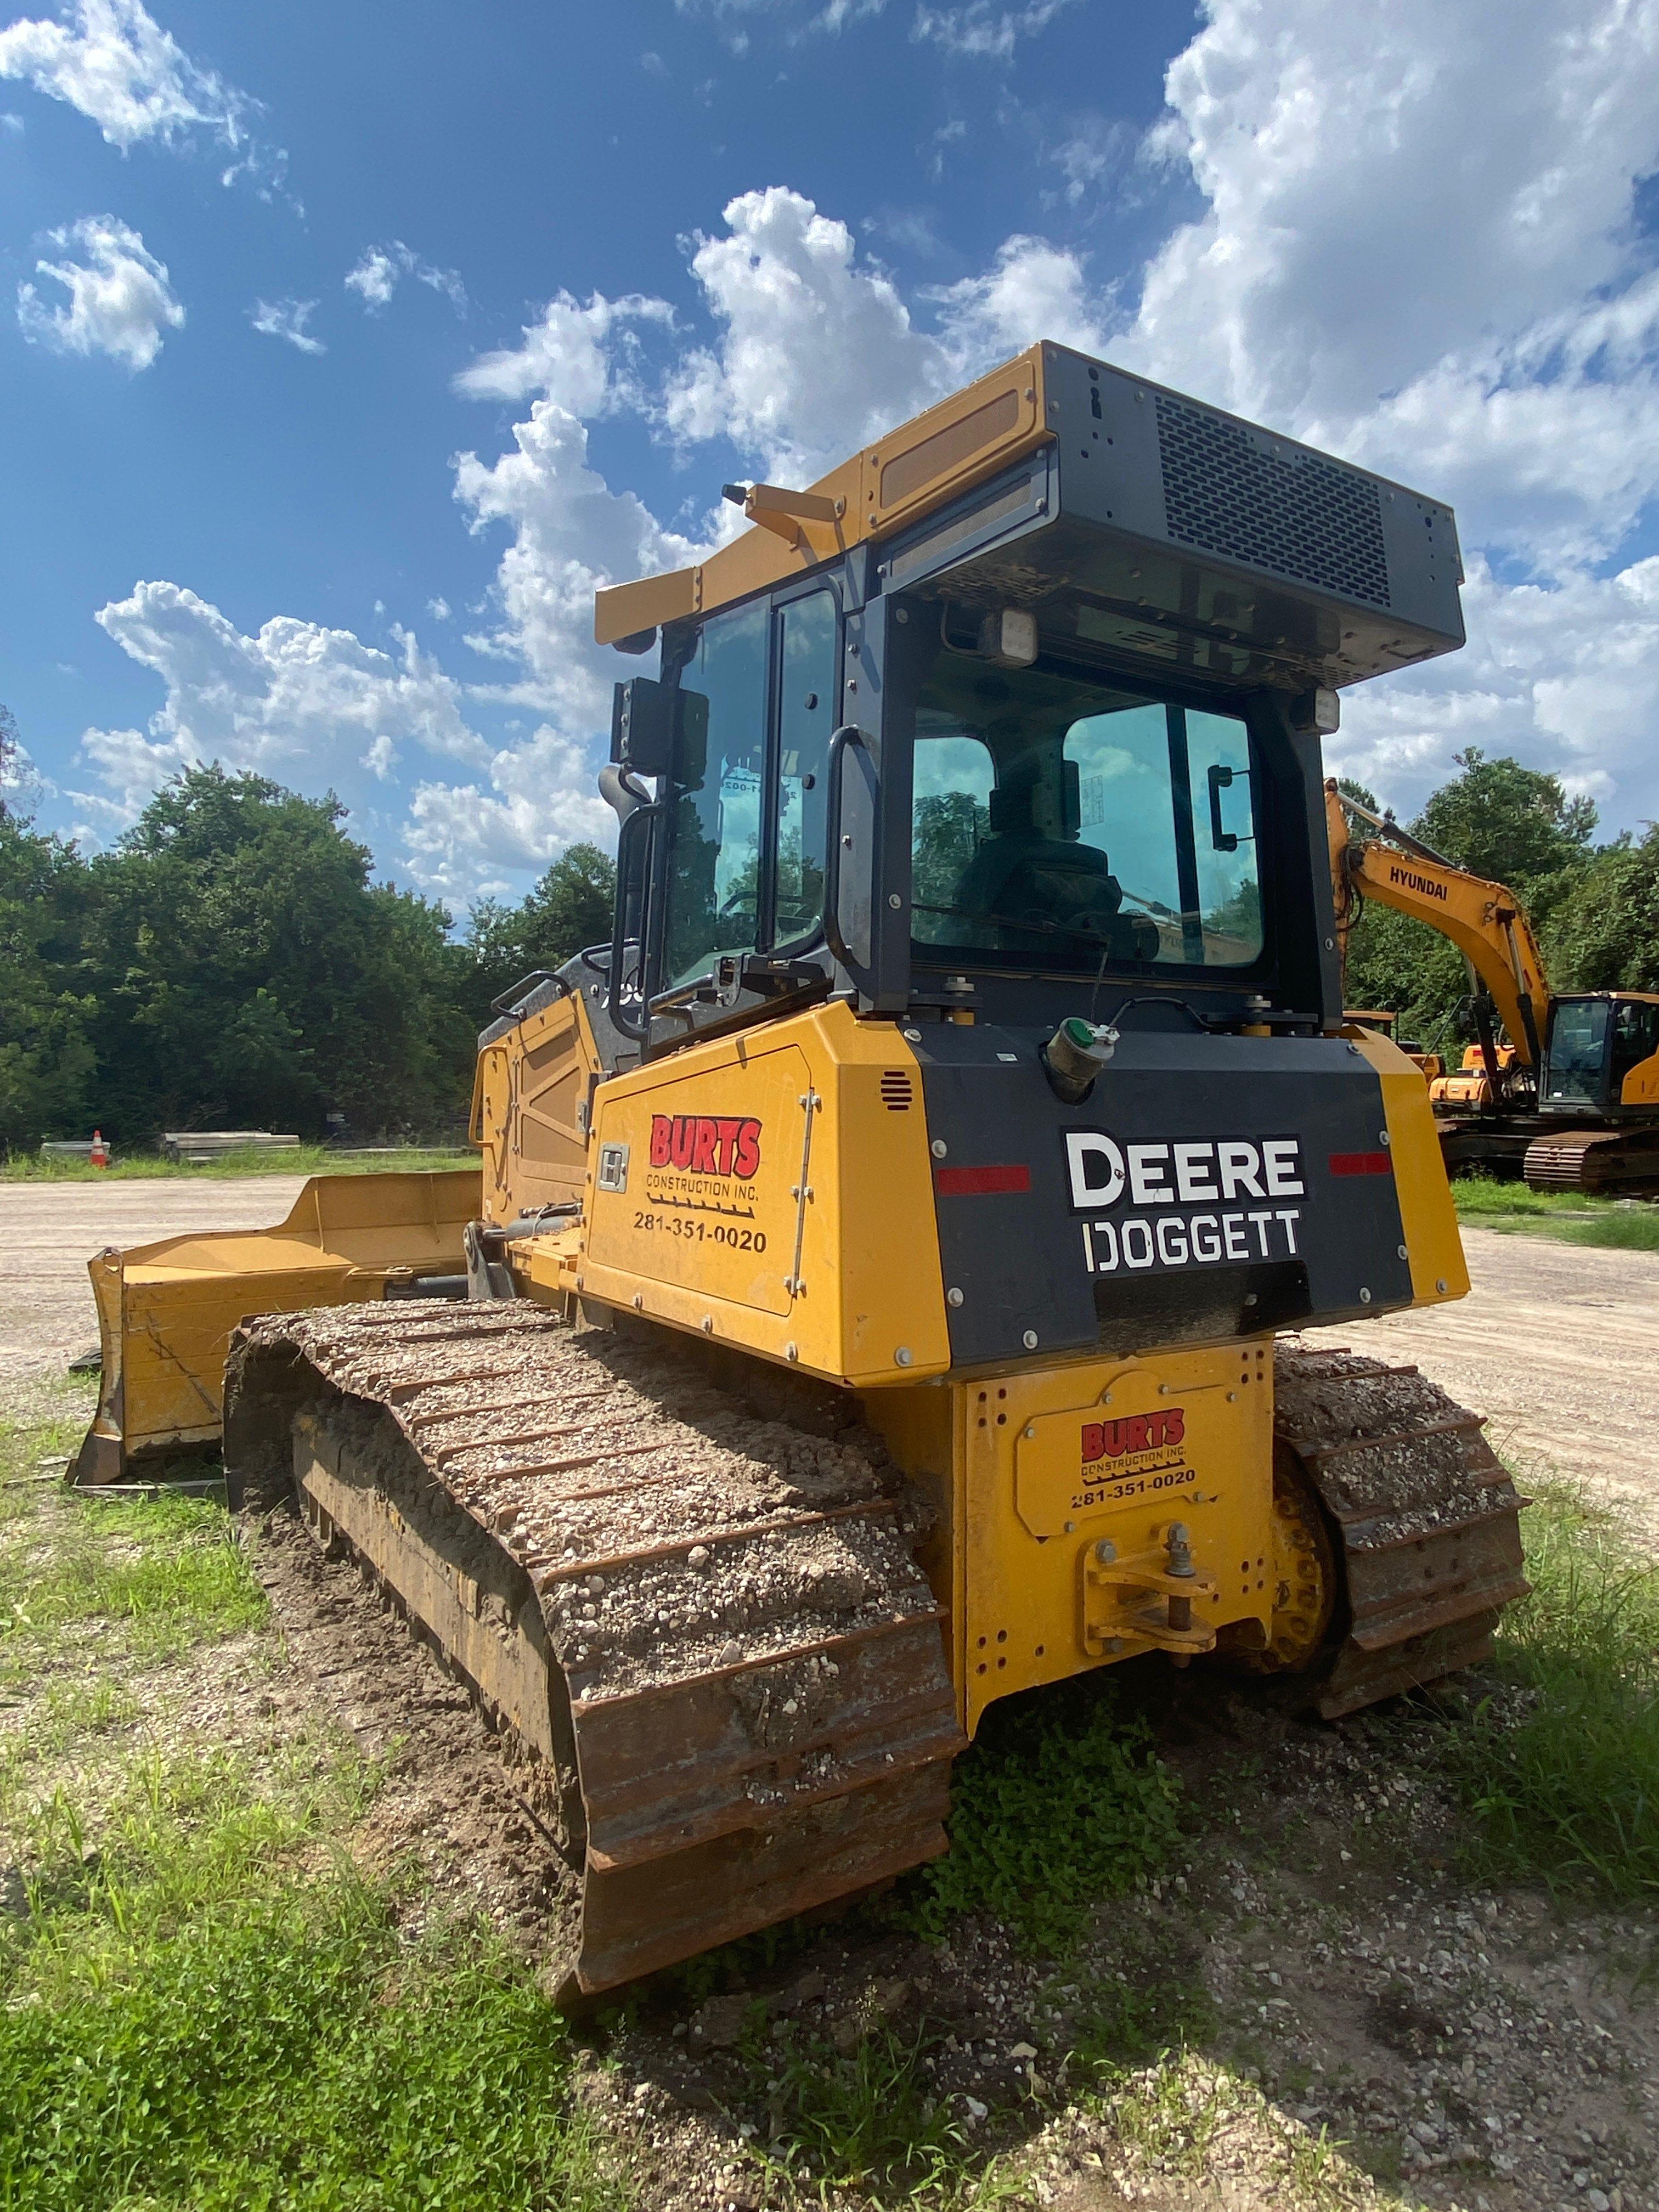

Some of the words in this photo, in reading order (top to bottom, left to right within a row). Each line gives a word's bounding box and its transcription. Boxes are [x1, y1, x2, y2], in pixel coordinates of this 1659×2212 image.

[1390, 866, 1448, 901] HYUNDAI
[650, 1114, 763, 1180] BURTS
[646, 1174, 730, 1198] CONSTRUCTION
[734, 1184, 759, 1201] INC.
[1066, 1133, 1304, 1207] DEERE
[634, 1211, 766, 1253] 281-351-0020
[1081, 1209, 1300, 1272] DOGGETT
[1081, 1408, 1184, 1463] BURTS
[1081, 1452, 1164, 1476] CONSTRUCTION
[1166, 1446, 1187, 1458] INC.
[1071, 1469, 1195, 1509] 281-351-0020
